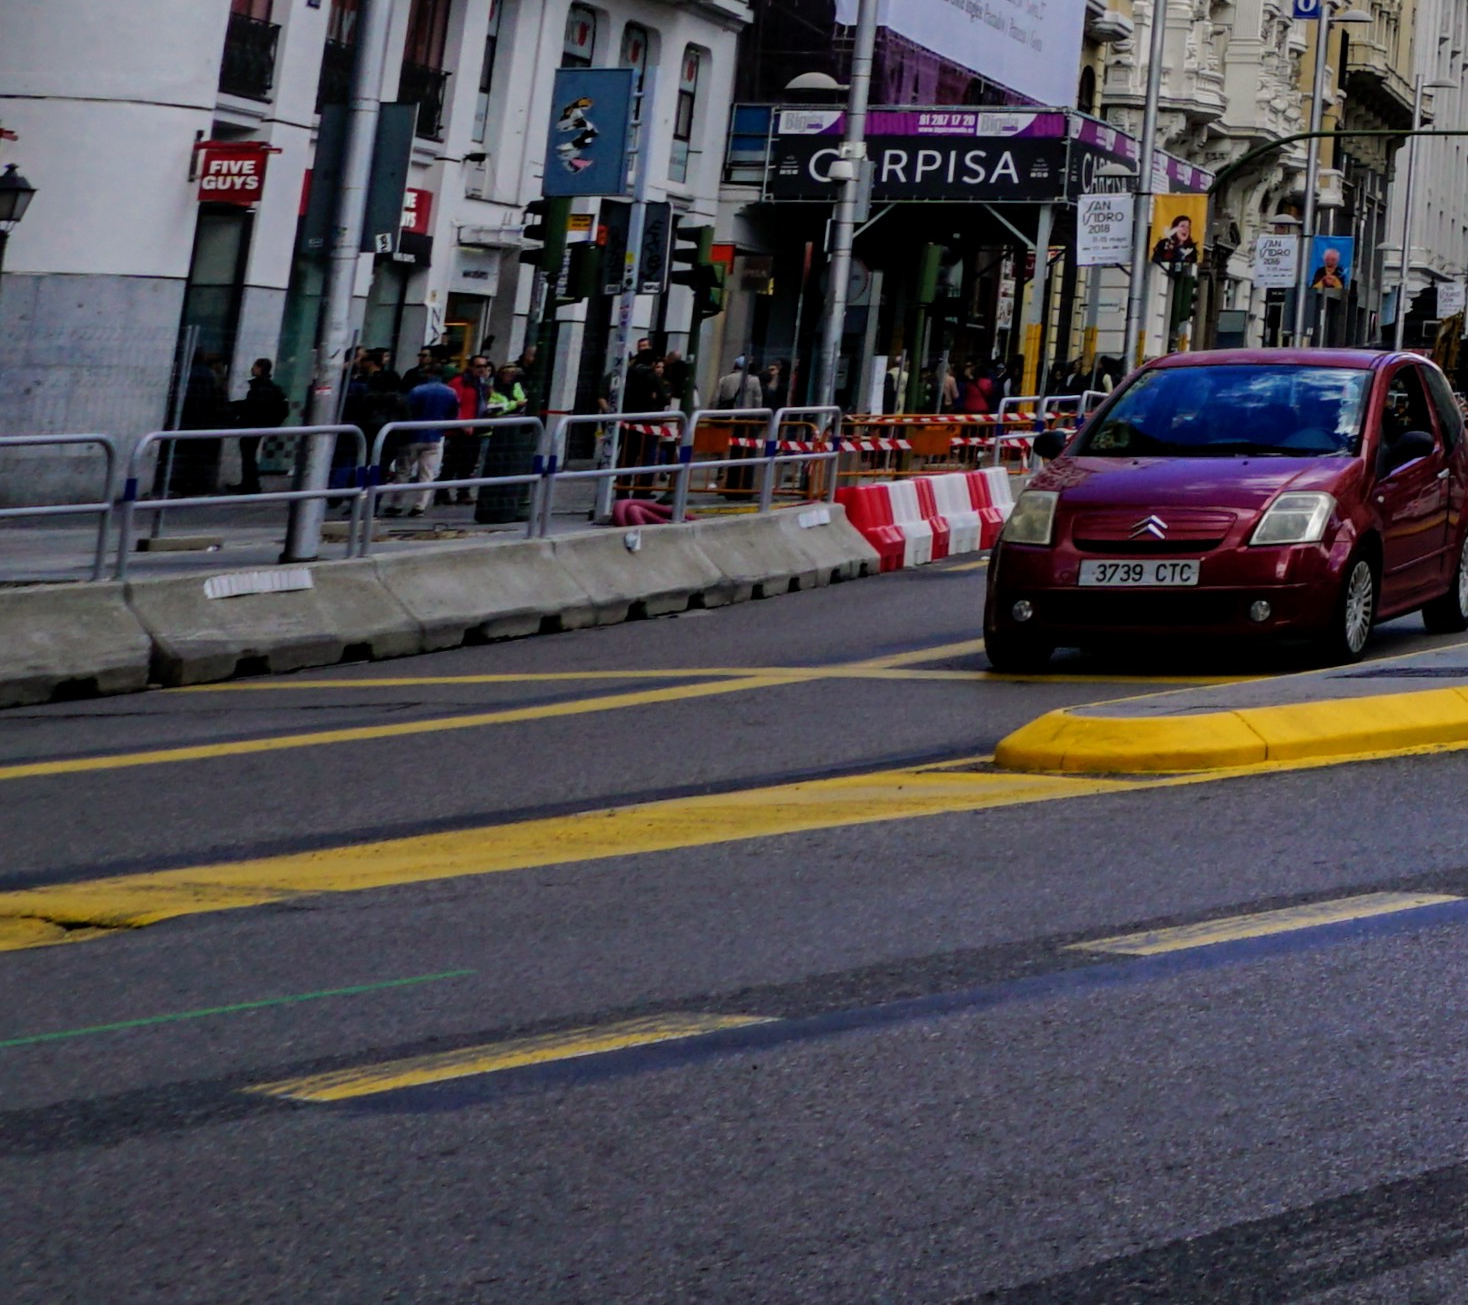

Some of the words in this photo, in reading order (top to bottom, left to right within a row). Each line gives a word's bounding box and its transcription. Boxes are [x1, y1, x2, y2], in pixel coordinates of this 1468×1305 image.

[208, 160, 256, 175] FIVE
[808, 148, 1020, 184] CRPISA
[202, 175, 259, 190] GUYS
[1085, 200, 1111, 214] SAN
[1088, 223, 1111, 234] 2018
[1095, 563, 1144, 583] 3739
[1155, 563, 1192, 583] CTC
